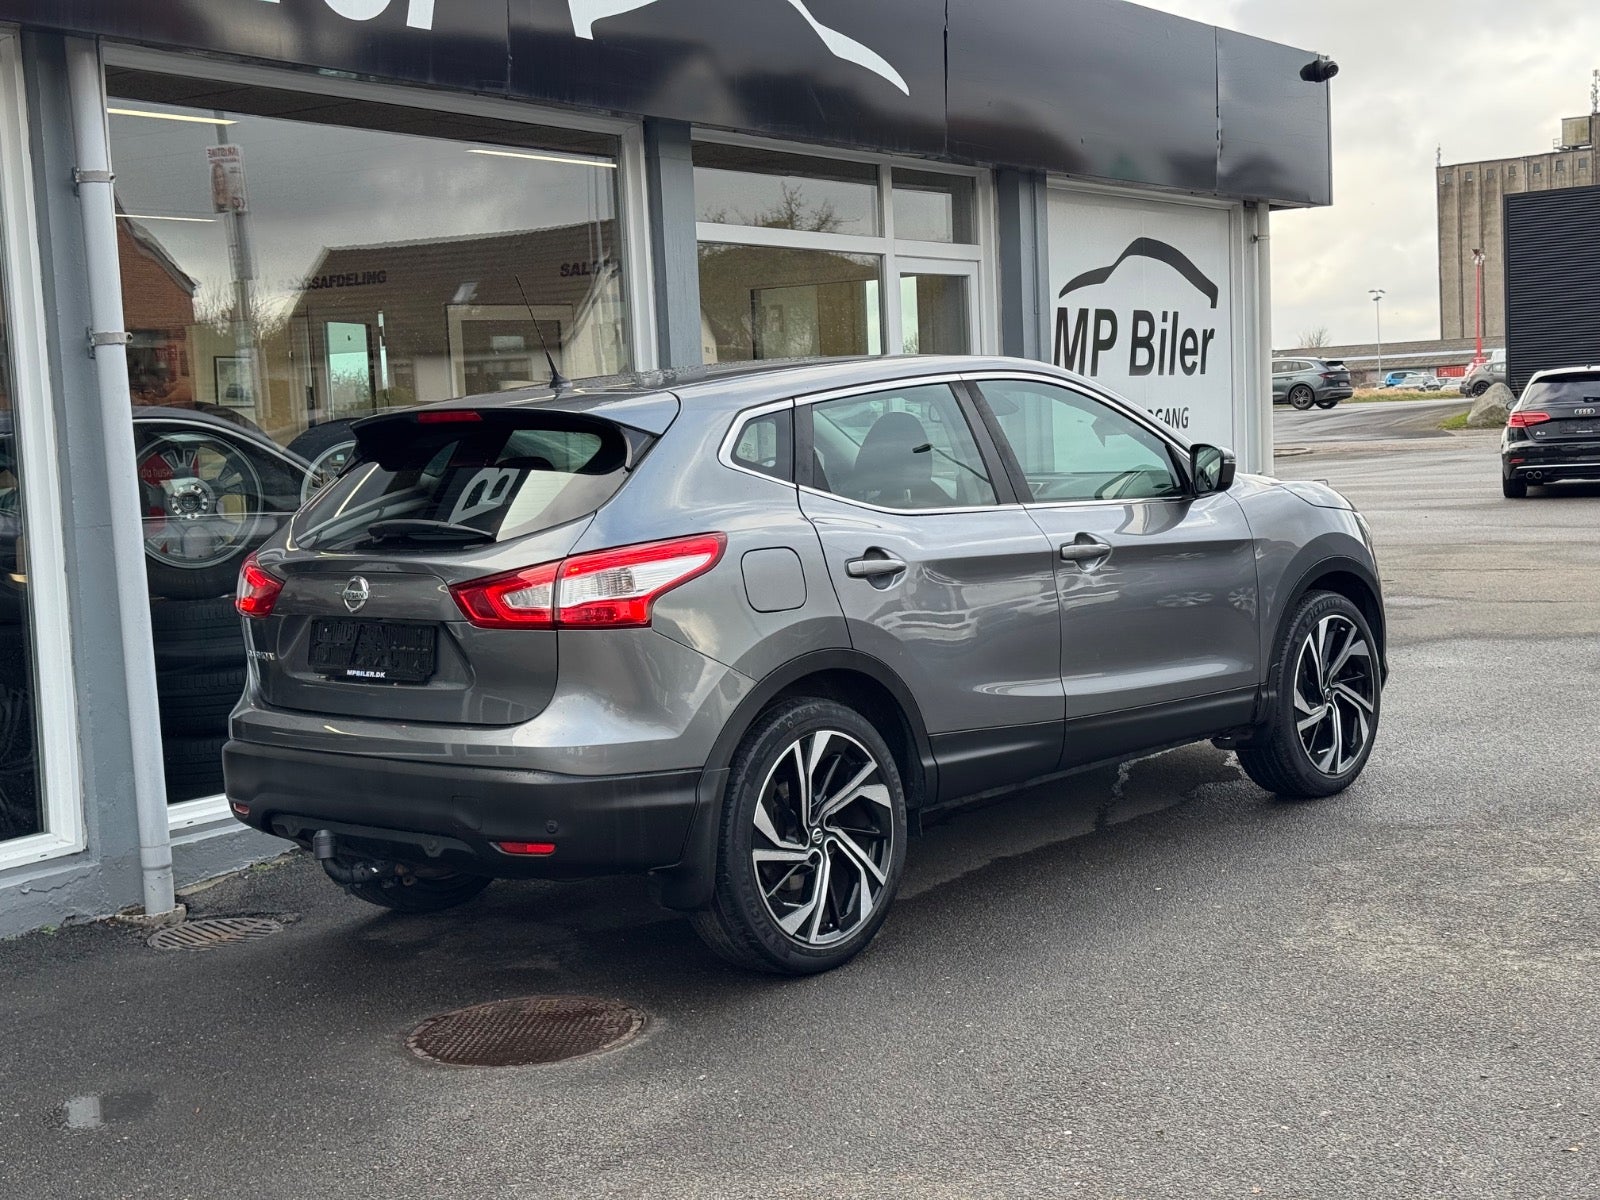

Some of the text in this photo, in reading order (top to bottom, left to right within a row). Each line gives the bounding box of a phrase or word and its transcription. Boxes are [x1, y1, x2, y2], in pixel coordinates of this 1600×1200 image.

[1053, 307, 1216, 377] MP Biler
[1146, 406, 1190, 429] GANG
[346, 669, 386, 679] MPBILER.DK
